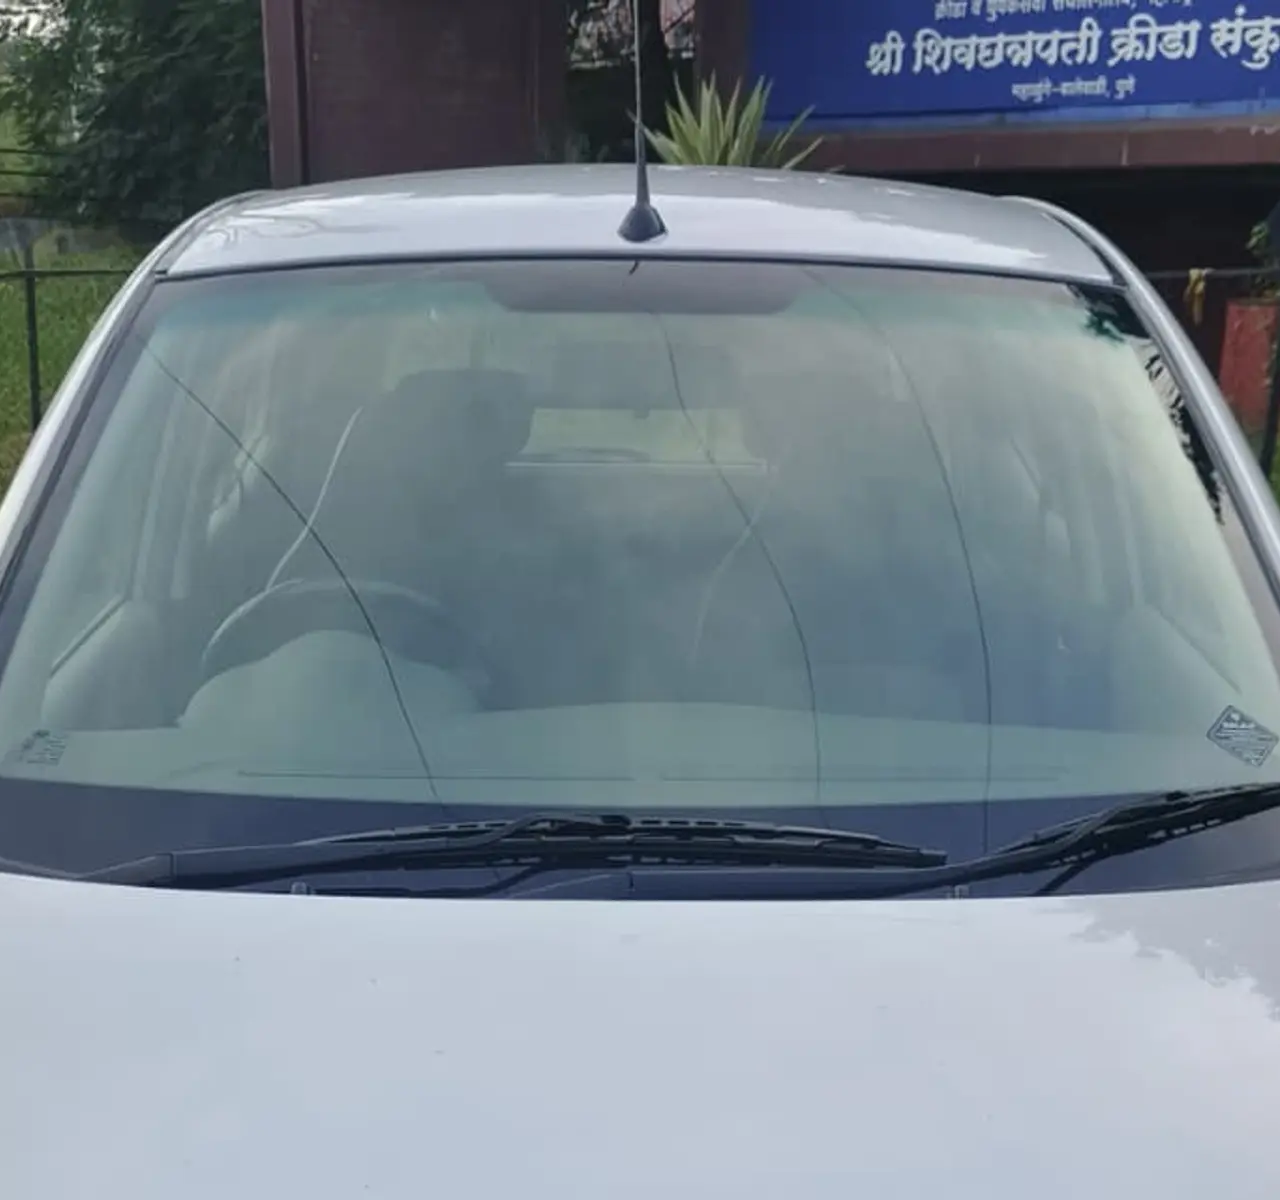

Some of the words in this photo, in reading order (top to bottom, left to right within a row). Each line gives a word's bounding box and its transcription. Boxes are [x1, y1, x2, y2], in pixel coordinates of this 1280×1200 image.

[866, 30, 905, 75] श्री
[912, 16, 1104, 75] शिवछत्रपती
[1107, 13, 1202, 67] क्रीडा
